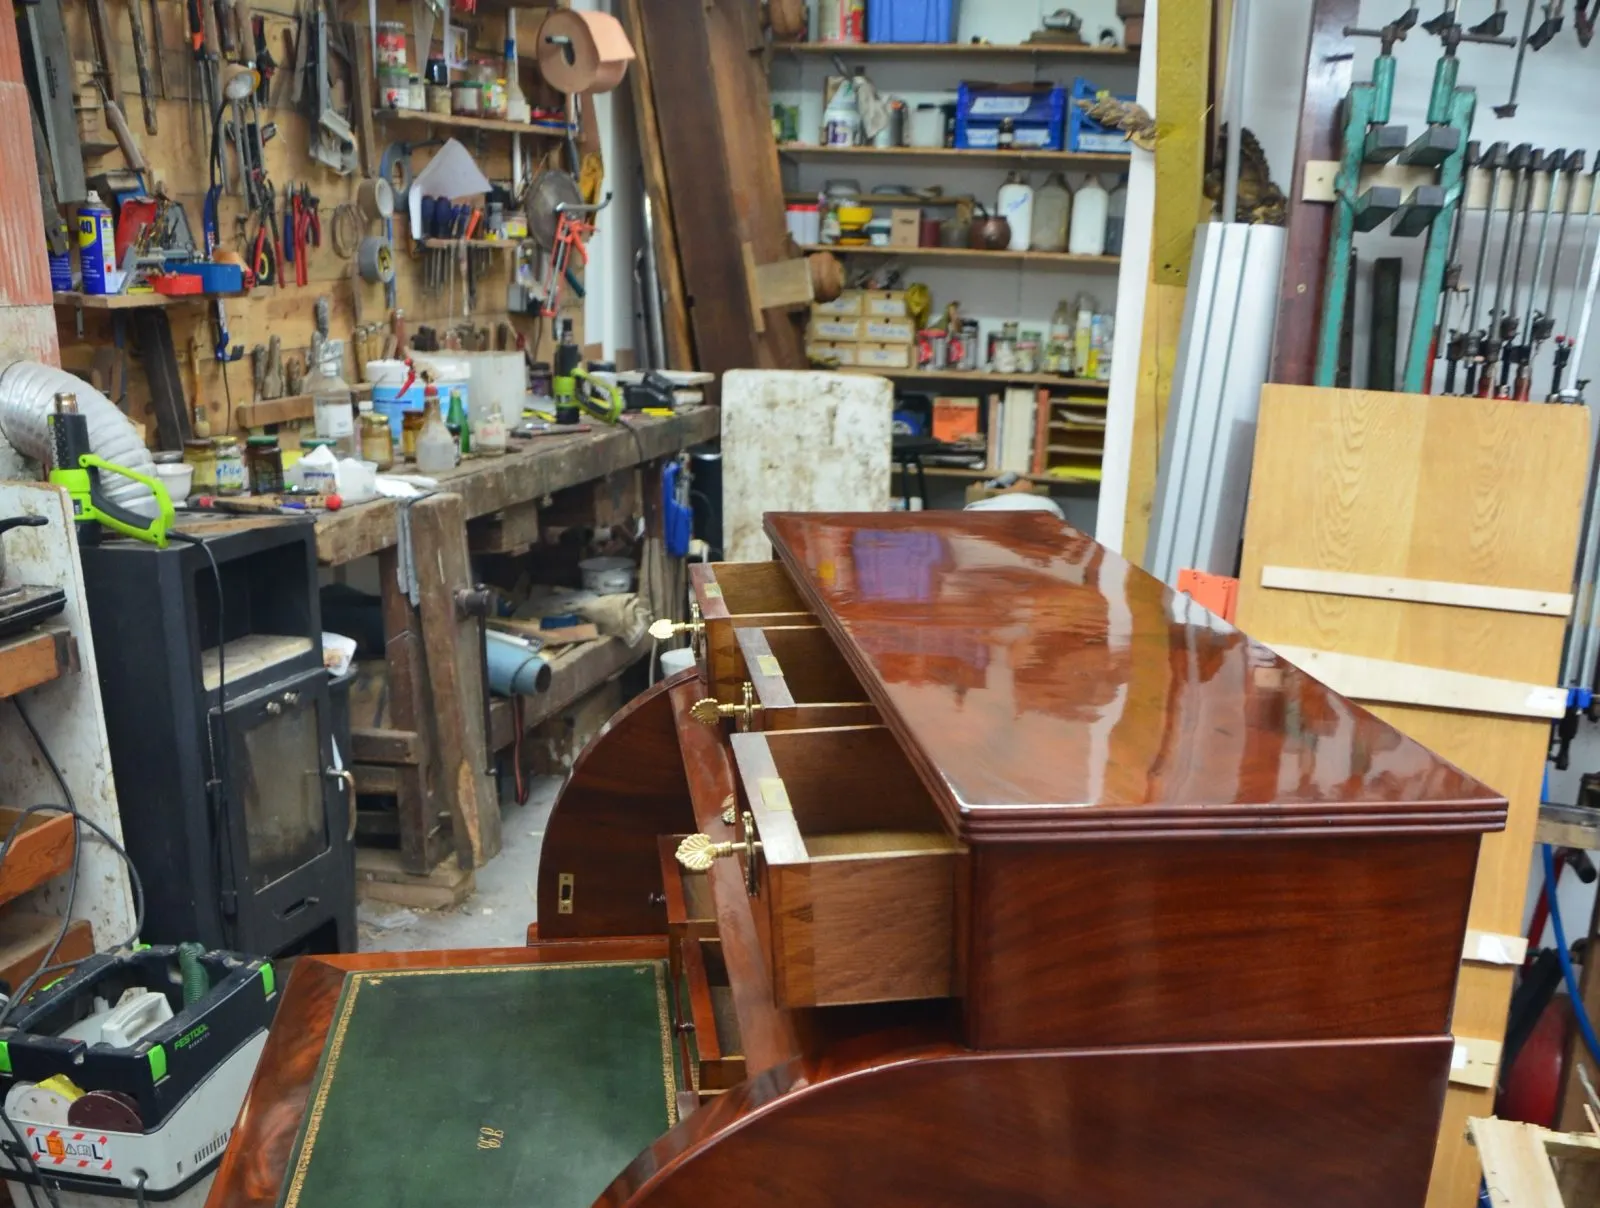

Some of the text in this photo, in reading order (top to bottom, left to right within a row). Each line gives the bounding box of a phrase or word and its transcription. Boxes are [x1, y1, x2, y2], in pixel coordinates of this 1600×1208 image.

[174, 1023, 208, 1051] FESTOOL
[35, 1136, 104, 1160] L L
